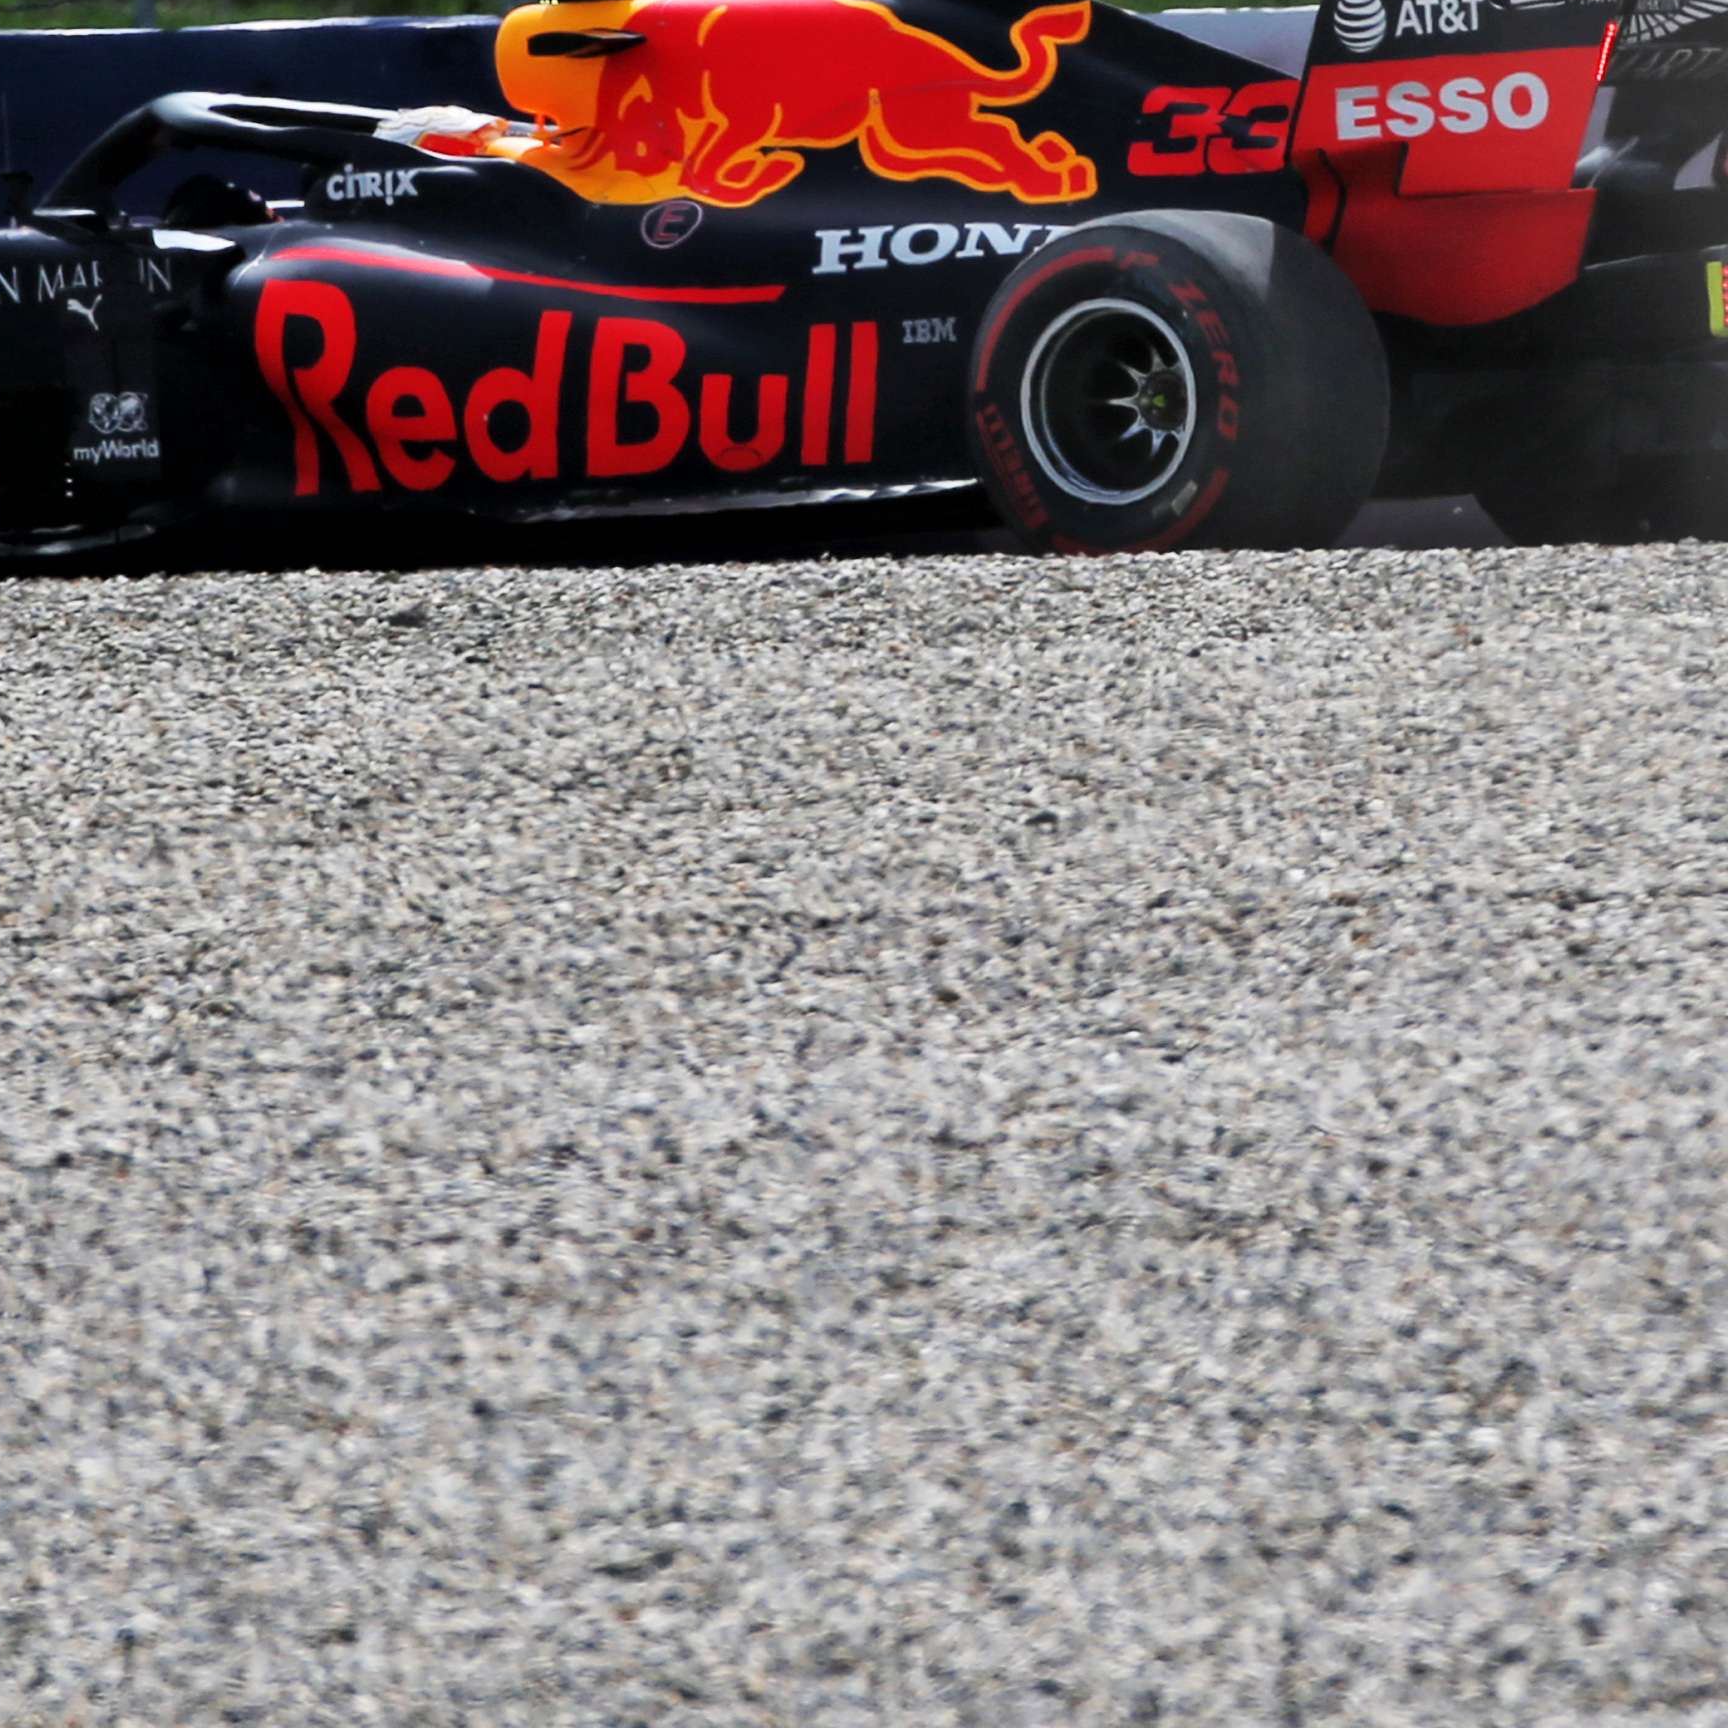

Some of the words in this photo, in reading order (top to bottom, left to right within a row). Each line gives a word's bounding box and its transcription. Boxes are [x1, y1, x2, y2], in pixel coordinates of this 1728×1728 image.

[1127, 79, 1301, 177] 33
[1335, 71, 1550, 141] ESSO
[812, 222, 1074, 274] HON
[37, 257, 171, 303] MAIN
[902, 316, 958, 344] IBM
[1167, 276, 1241, 441] ZERO
[73, 438, 160, 466] myWorld
